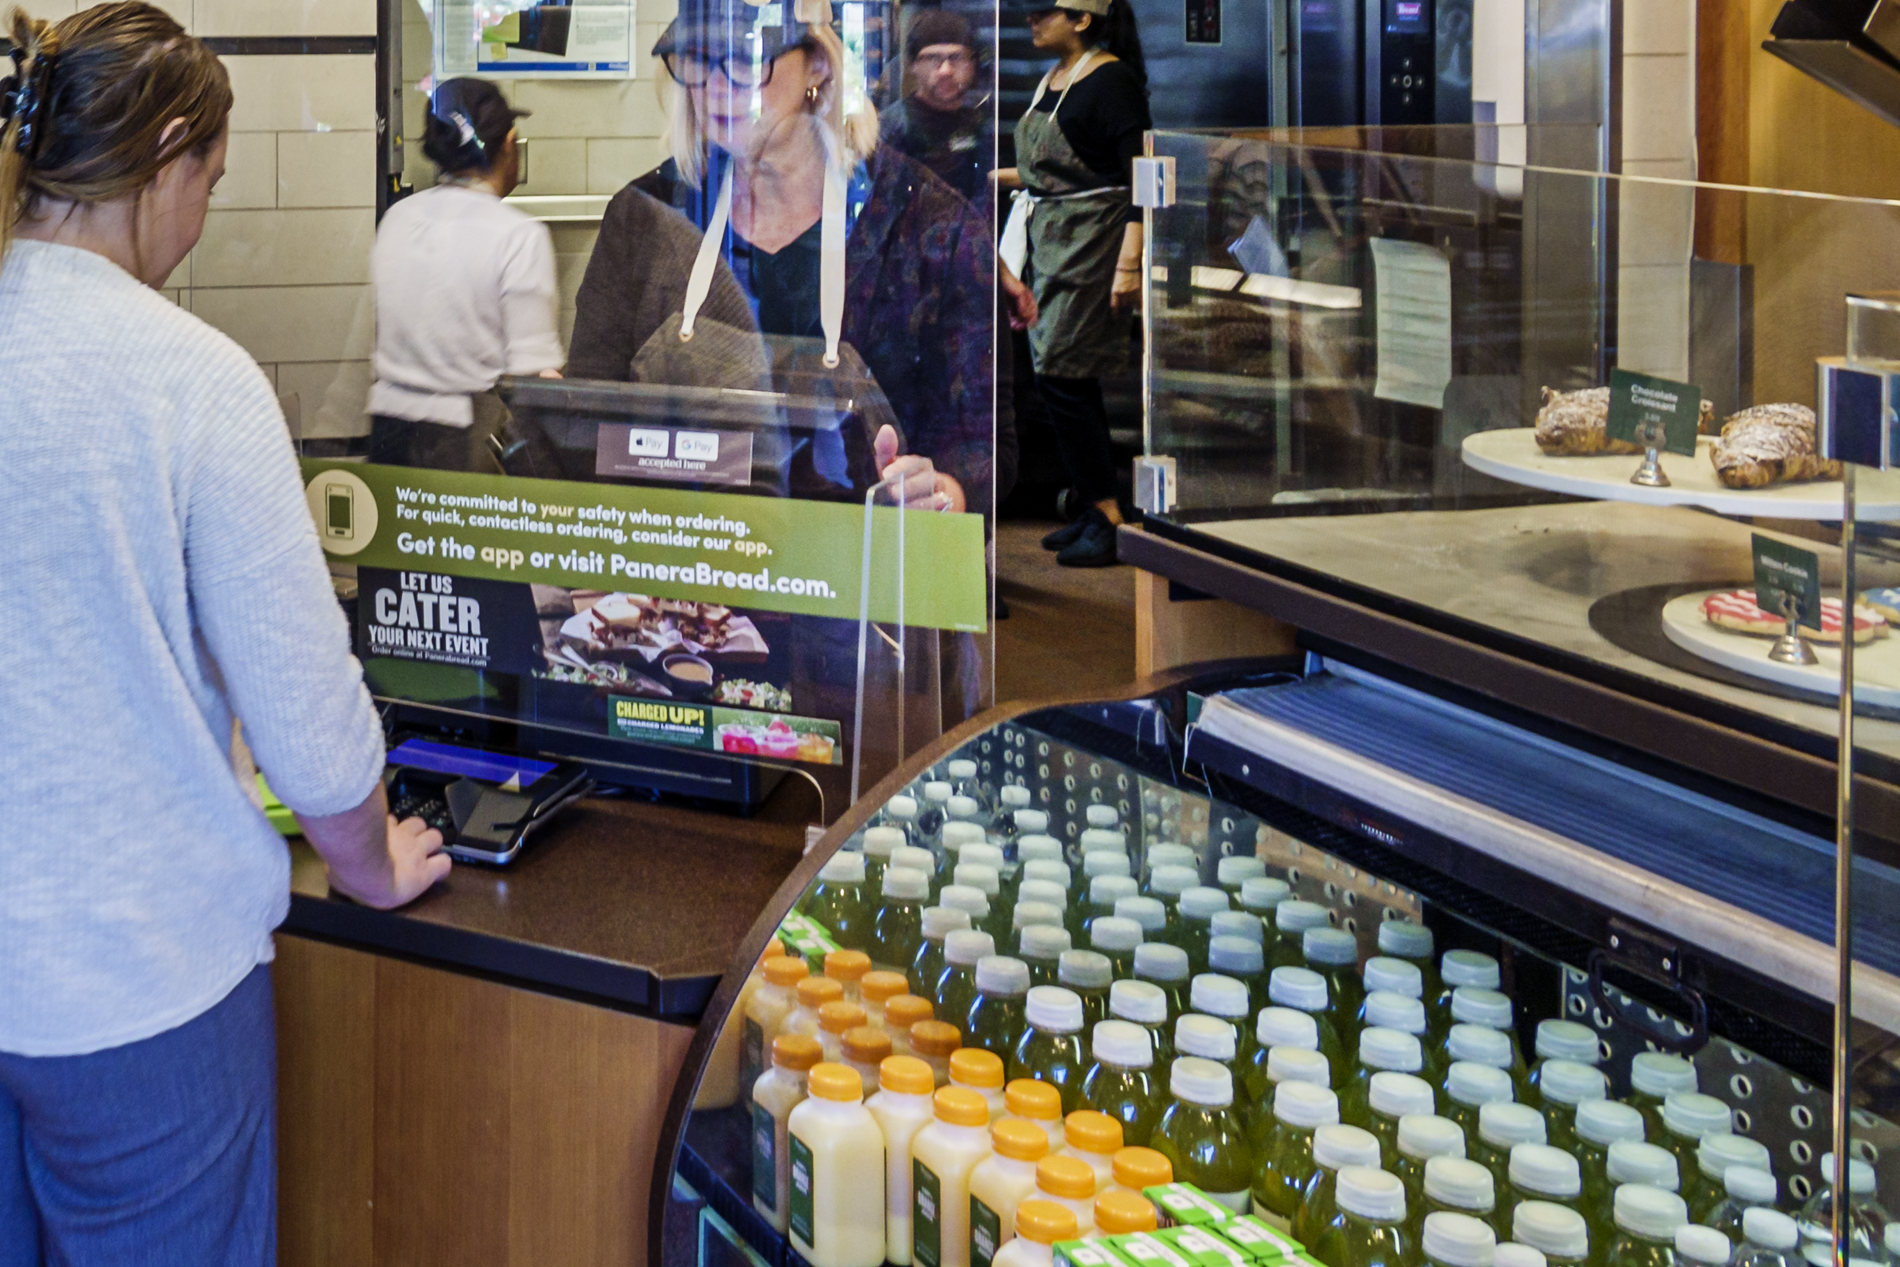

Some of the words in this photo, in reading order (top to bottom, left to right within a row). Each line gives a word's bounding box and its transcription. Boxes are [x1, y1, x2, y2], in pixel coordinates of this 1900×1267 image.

[1631, 384, 1678, 403] Chocolate
[1631, 393, 1676, 413] Croissant
[638, 456, 680, 470] accepted
[683, 459, 706, 472] here
[396, 486, 437, 505] We're
[440, 492, 518, 513] committed
[521, 501, 537, 514] to
[540, 502, 574, 519] your
[577, 505, 626, 527] safety
[629, 509, 672, 527] when
[676, 511, 751, 537] ordering.
[397, 504, 419, 520] For
[422, 507, 466, 527] quick,
[469, 512, 553, 534] contactless
[556, 521, 628, 544] ordering,
[631, 526, 700, 548] consider
[703, 536, 731, 550] our
[734, 538, 773, 558] app.
[397, 533, 436, 555] Get
[440, 537, 476, 561] the
[481, 546, 524, 570] app
[529, 552, 554, 568] or
[558, 549, 605, 574] visit
[610, 554, 837, 599] PaneraBread.com.
[400, 572, 428, 591] LET
[430, 574, 453, 593] US
[375, 588, 481, 635] CATER
[368, 624, 405, 645] YOUR
[407, 626, 443, 651] NEXT
[445, 634, 489, 656] EVENT
[616, 700, 667, 723] CHARGED
[669, 707, 705, 726] UP!
